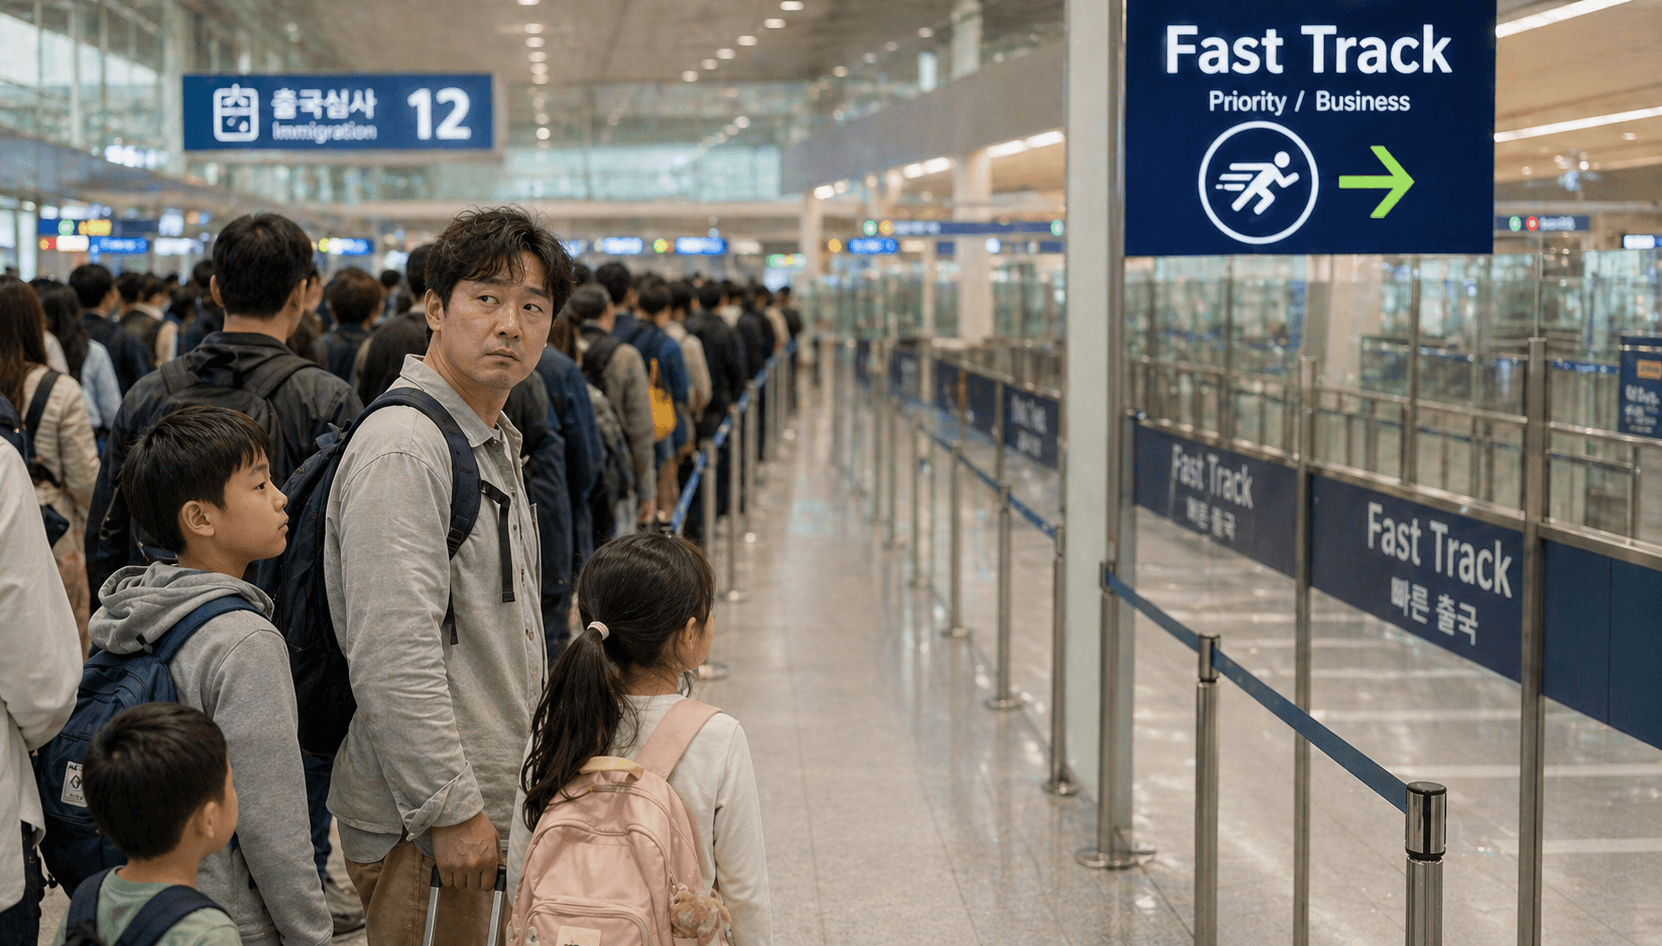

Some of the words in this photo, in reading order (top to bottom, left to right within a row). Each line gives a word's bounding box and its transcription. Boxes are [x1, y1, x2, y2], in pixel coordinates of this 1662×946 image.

[1166, 24, 1284, 74] Fast
[1300, 24, 1453, 74] Track
[271, 88, 378, 119] 출국심사
[407, 87, 472, 140] 12
[1209, 90, 1287, 116] Priority
[1316, 90, 1411, 112] Business
[272, 121, 377, 144] Immigration
[1172, 444, 1204, 491] Fast
[1207, 453, 1253, 509] Track
[1368, 501, 1421, 566] Fast
[1430, 519, 1512, 598] Track
[1391, 576, 1430, 624] 빠른
[1436, 594, 1479, 646] 출국
